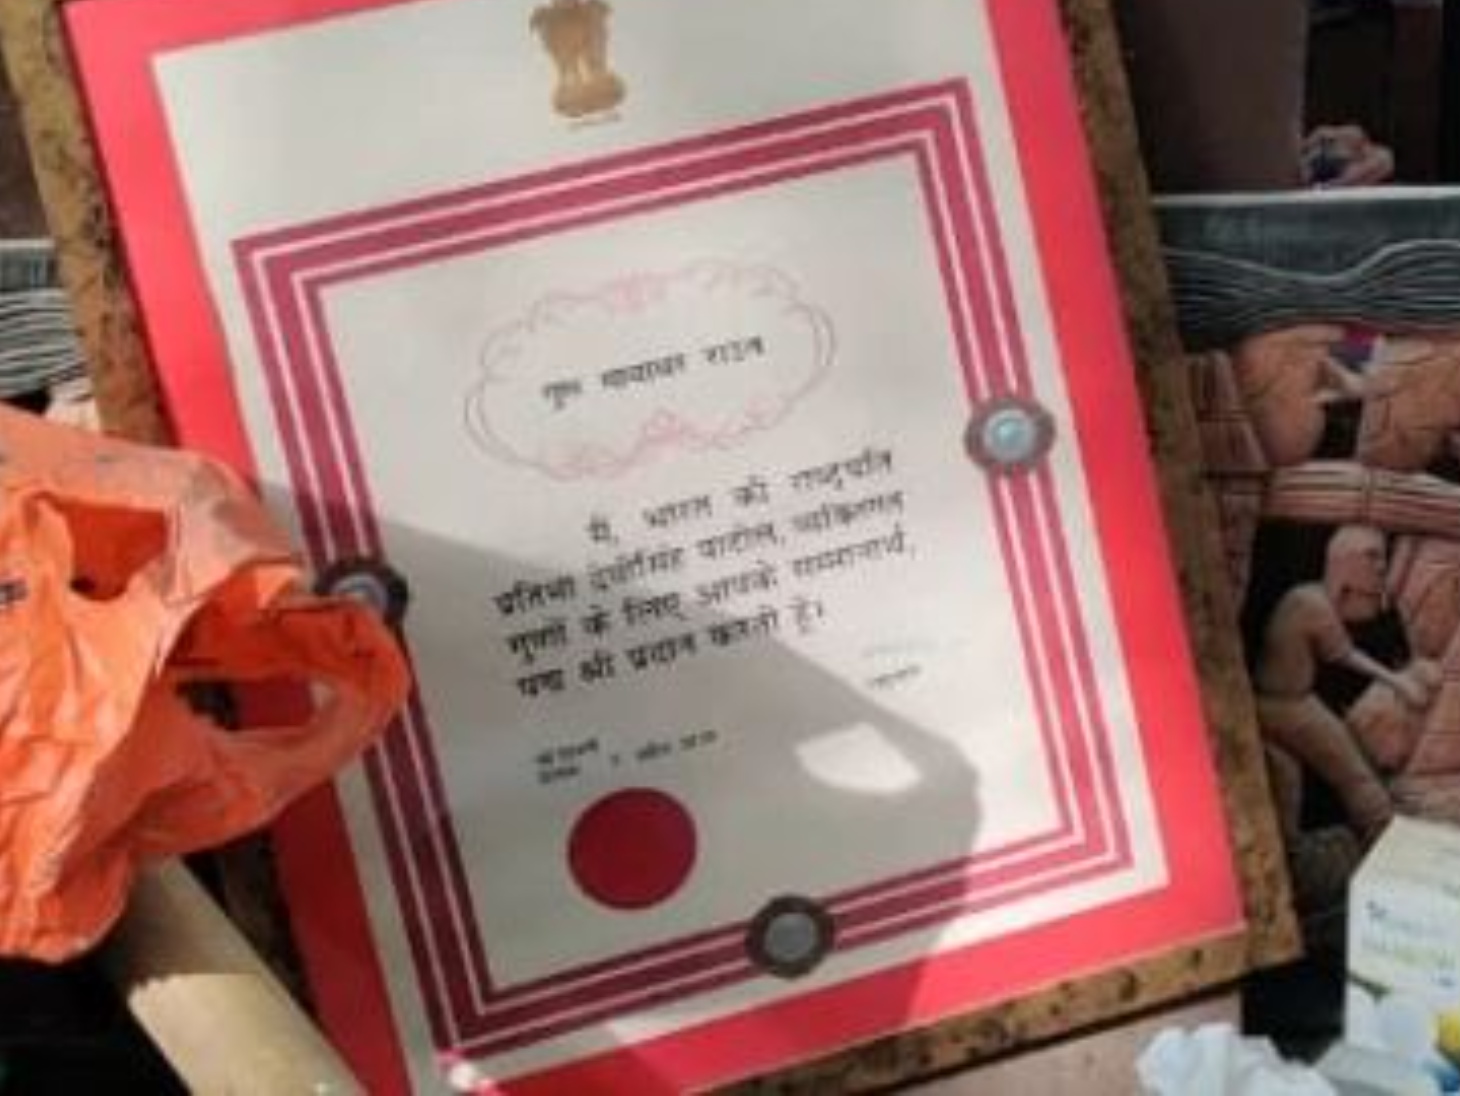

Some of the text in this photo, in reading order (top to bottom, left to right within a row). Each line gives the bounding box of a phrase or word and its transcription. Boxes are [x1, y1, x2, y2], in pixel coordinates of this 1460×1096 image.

[643, 496, 713, 531] भारत
[733, 477, 770, 508] की
[582, 606, 614, 637] के
[622, 590, 687, 630] लिए
[698, 560, 779, 607] आपके
[626, 631, 700, 669] प्रदान
[710, 606, 780, 647] करती
